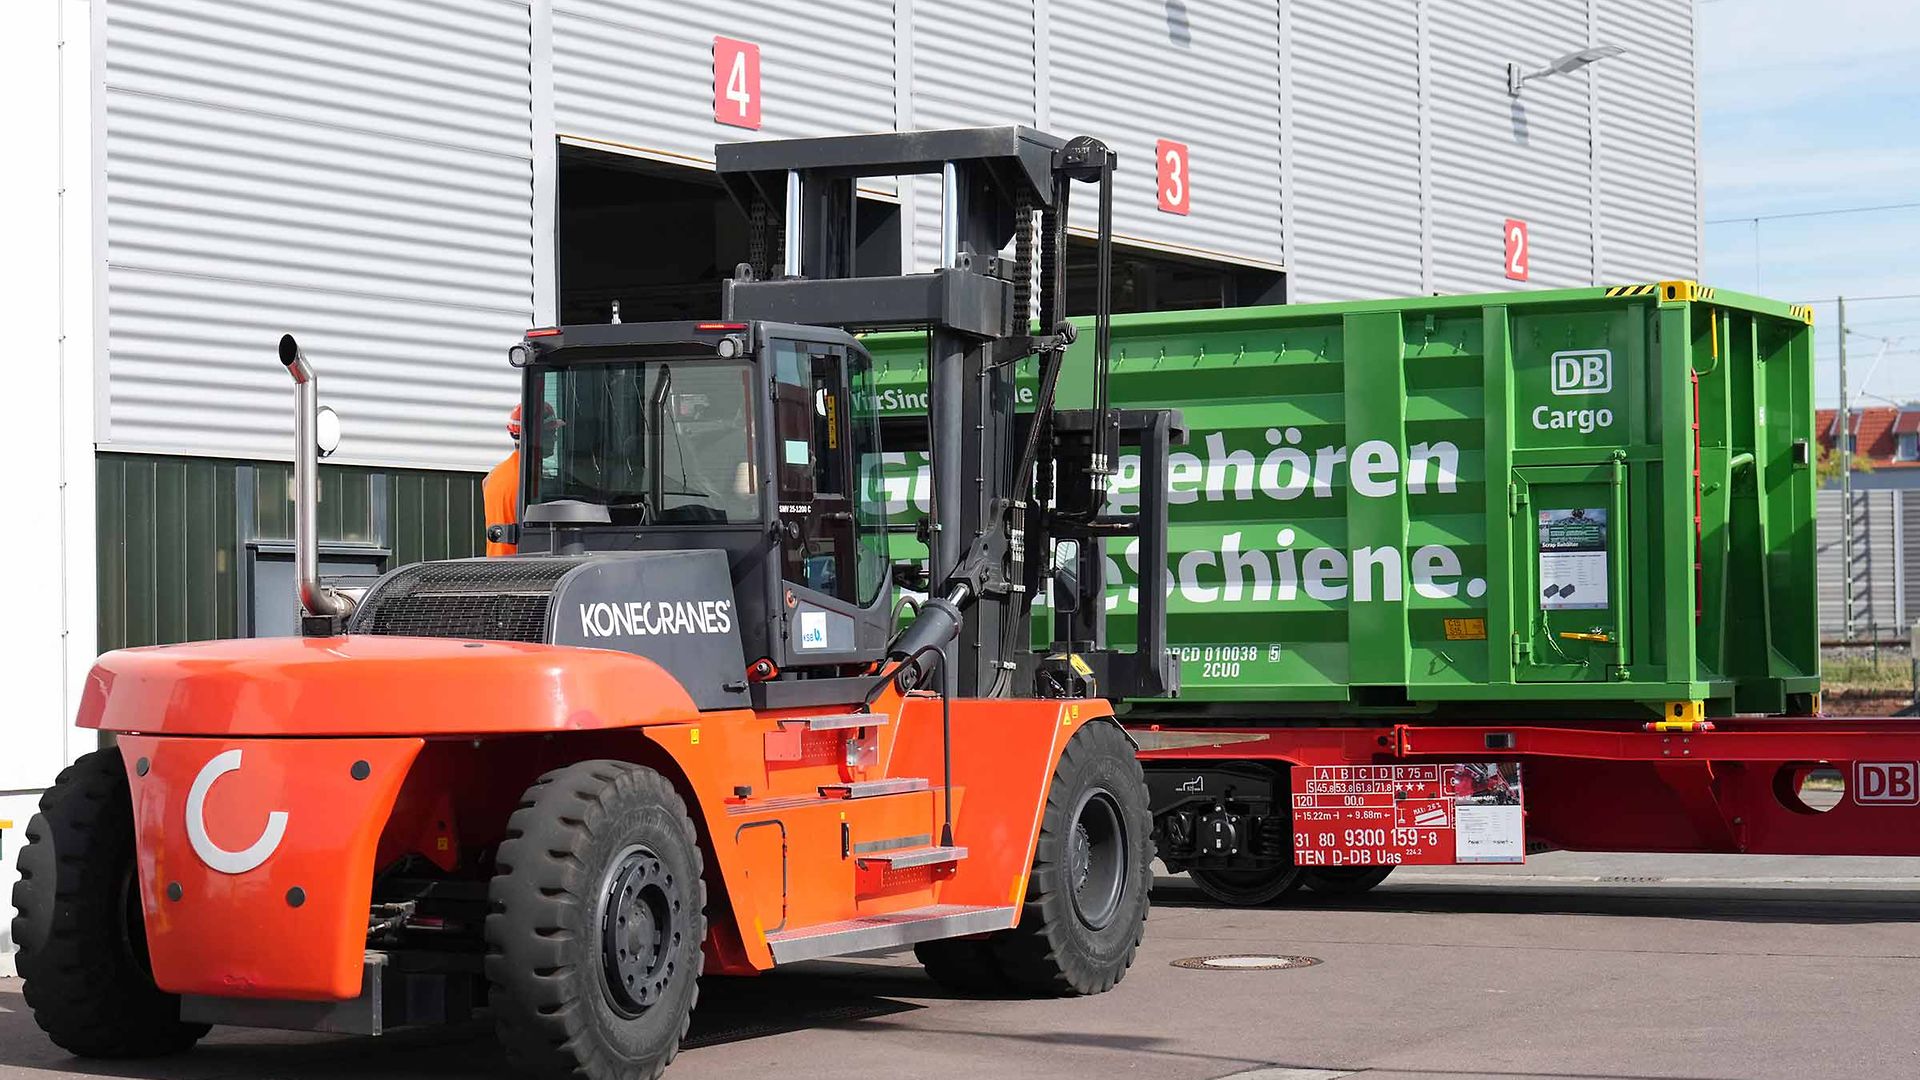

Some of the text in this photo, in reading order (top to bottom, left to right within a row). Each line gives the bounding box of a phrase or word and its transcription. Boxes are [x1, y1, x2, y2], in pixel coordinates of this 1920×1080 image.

[726, 51, 750, 117] 4
[1165, 150, 1183, 206] 3
[1511, 226, 1524, 274] 2
[1559, 357, 1605, 388] DB
[1532, 405, 1613, 434] Cargo
[1204, 646, 1258, 661] 010038
[1270, 646, 1279, 661] 5
[1320, 768, 1388, 779] A B C D
[1396, 767, 1433, 779] R 75 m
[1863, 767, 1911, 796] DB
[1308, 783, 1314, 793] S
[1296, 796, 1313, 807] 120
[1355, 811, 1382, 820] 9.68m
[1295, 833, 1310, 847] 31
[1319, 833, 1335, 847] 80
[1344, 828, 1385, 847] 9300
[1296, 850, 1325, 865] TEN
[1333, 850, 1371, 865] D-DB
[1377, 850, 1402, 864] Uas
